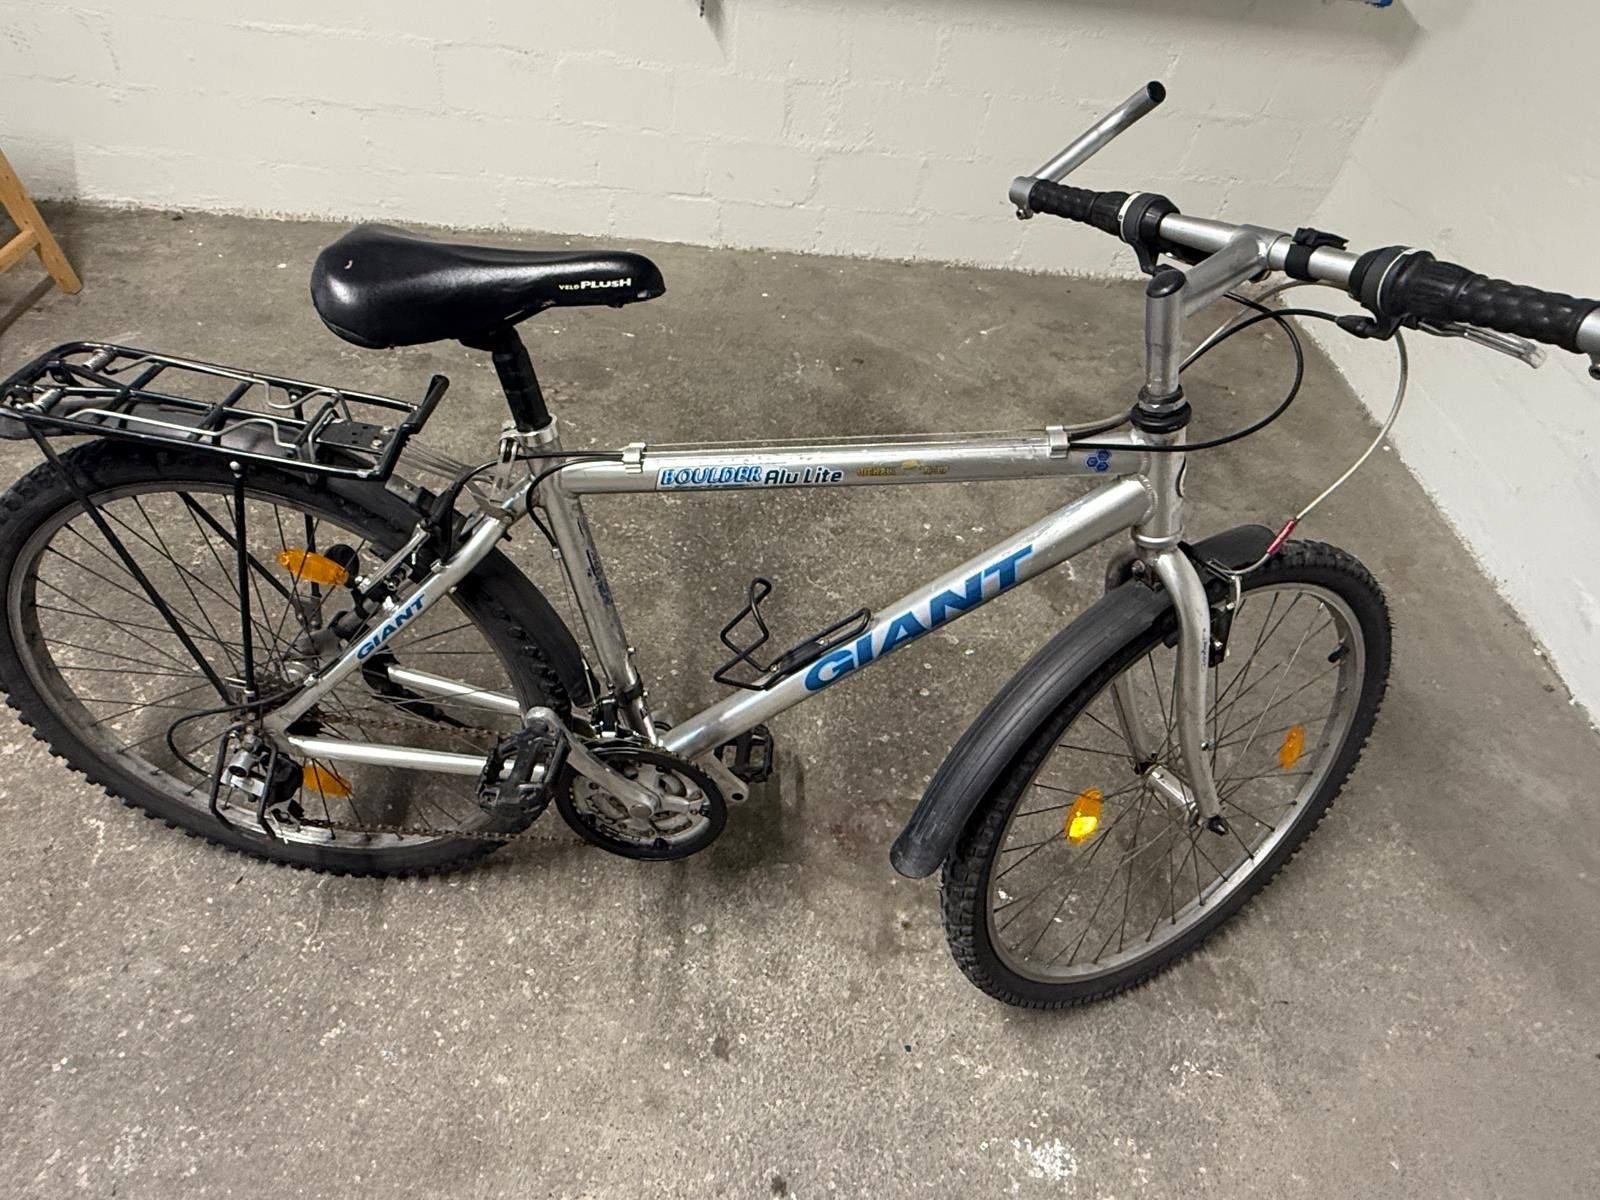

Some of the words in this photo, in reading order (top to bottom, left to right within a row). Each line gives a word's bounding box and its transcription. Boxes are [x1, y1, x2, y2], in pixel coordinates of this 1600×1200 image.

[580, 277, 632, 290] PLUSH
[660, 466, 763, 486] BOULDER
[764, 469, 799, 485] Alu
[802, 467, 843, 484] Lite
[357, 593, 425, 660] GIANT
[804, 543, 1033, 691] GIANT
